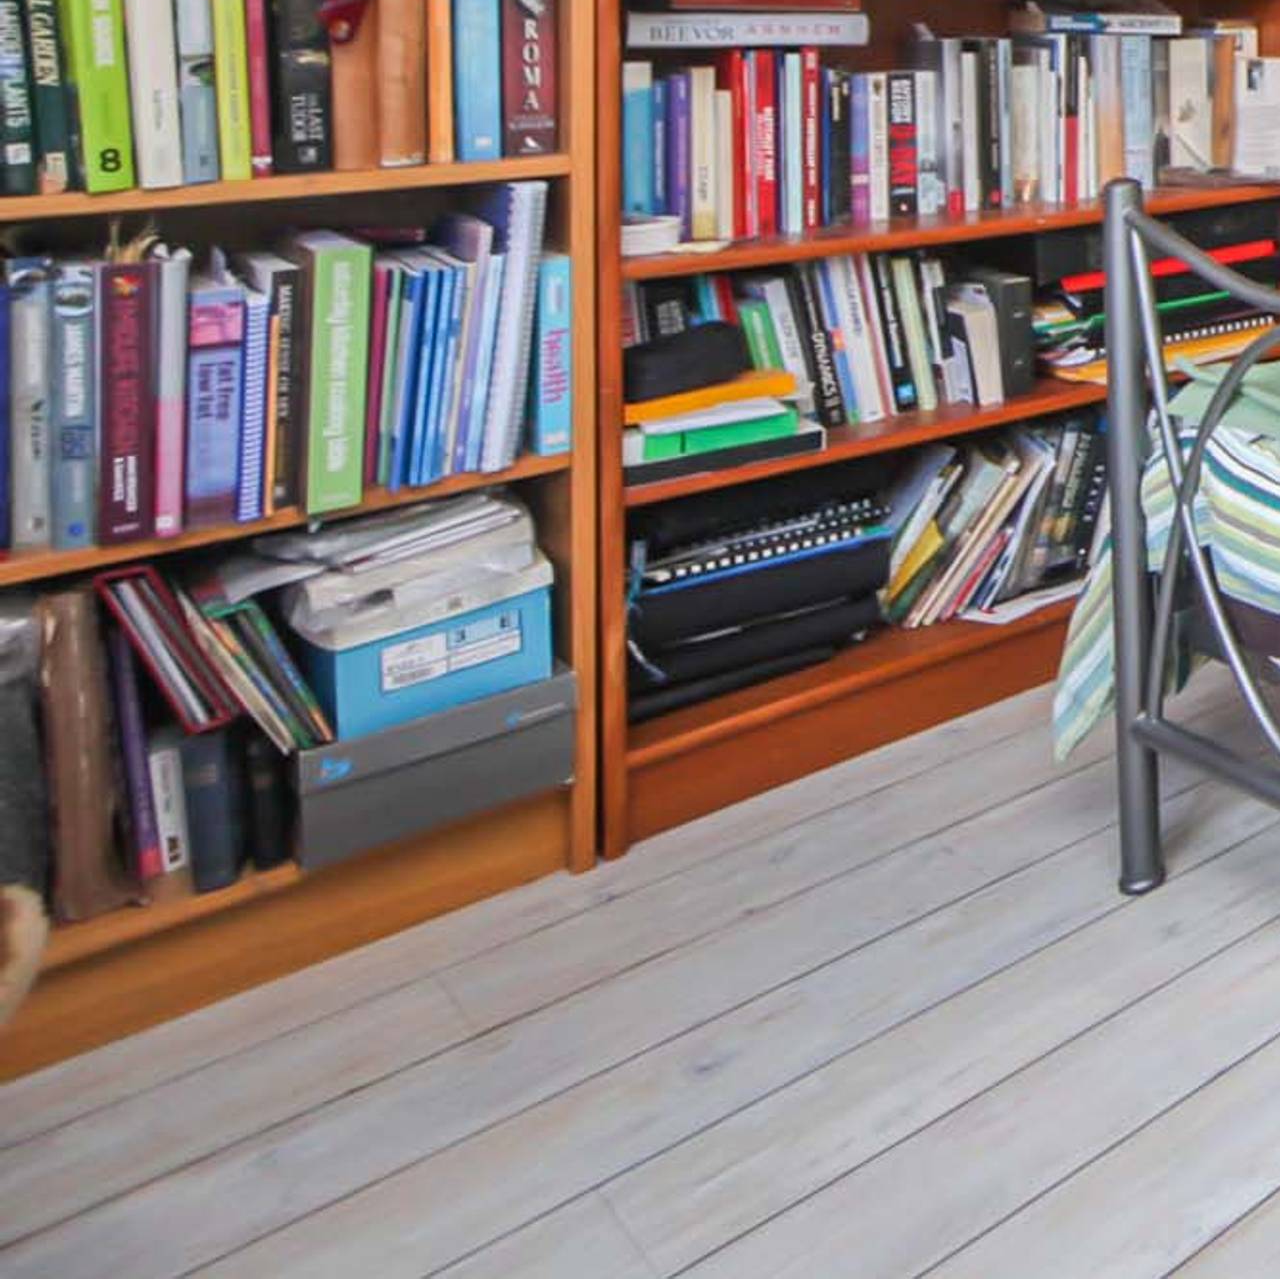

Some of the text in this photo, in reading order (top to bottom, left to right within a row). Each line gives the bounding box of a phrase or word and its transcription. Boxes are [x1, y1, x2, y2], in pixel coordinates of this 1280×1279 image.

[30, 12, 61, 88] GARDEN
[649, 24, 735, 42] BEEVOR
[521, 19, 542, 110] ROMA
[99, 148, 122, 172] 8
